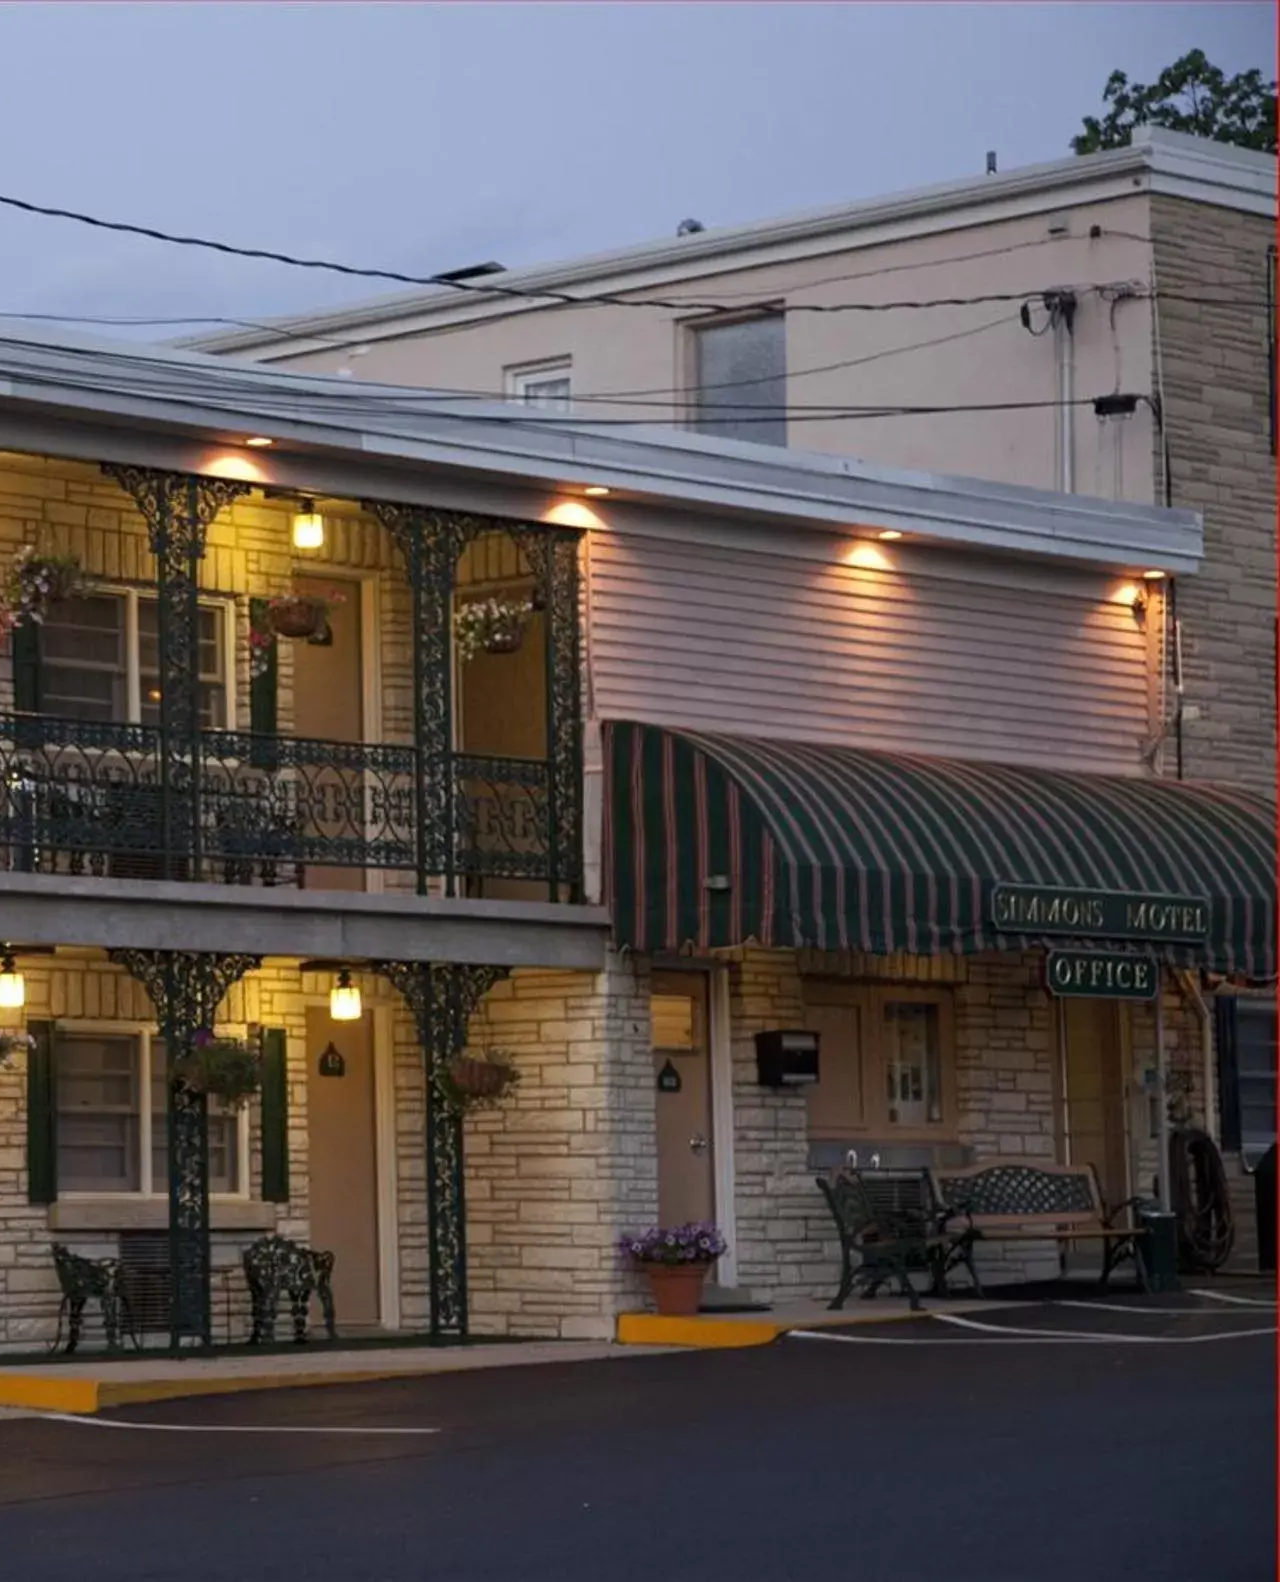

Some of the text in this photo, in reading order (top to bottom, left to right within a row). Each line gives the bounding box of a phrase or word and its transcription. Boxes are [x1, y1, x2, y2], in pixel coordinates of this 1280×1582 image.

[996, 892, 1207, 933] SIMMONS MOTEL
[1055, 957, 1149, 989] OFFICE
